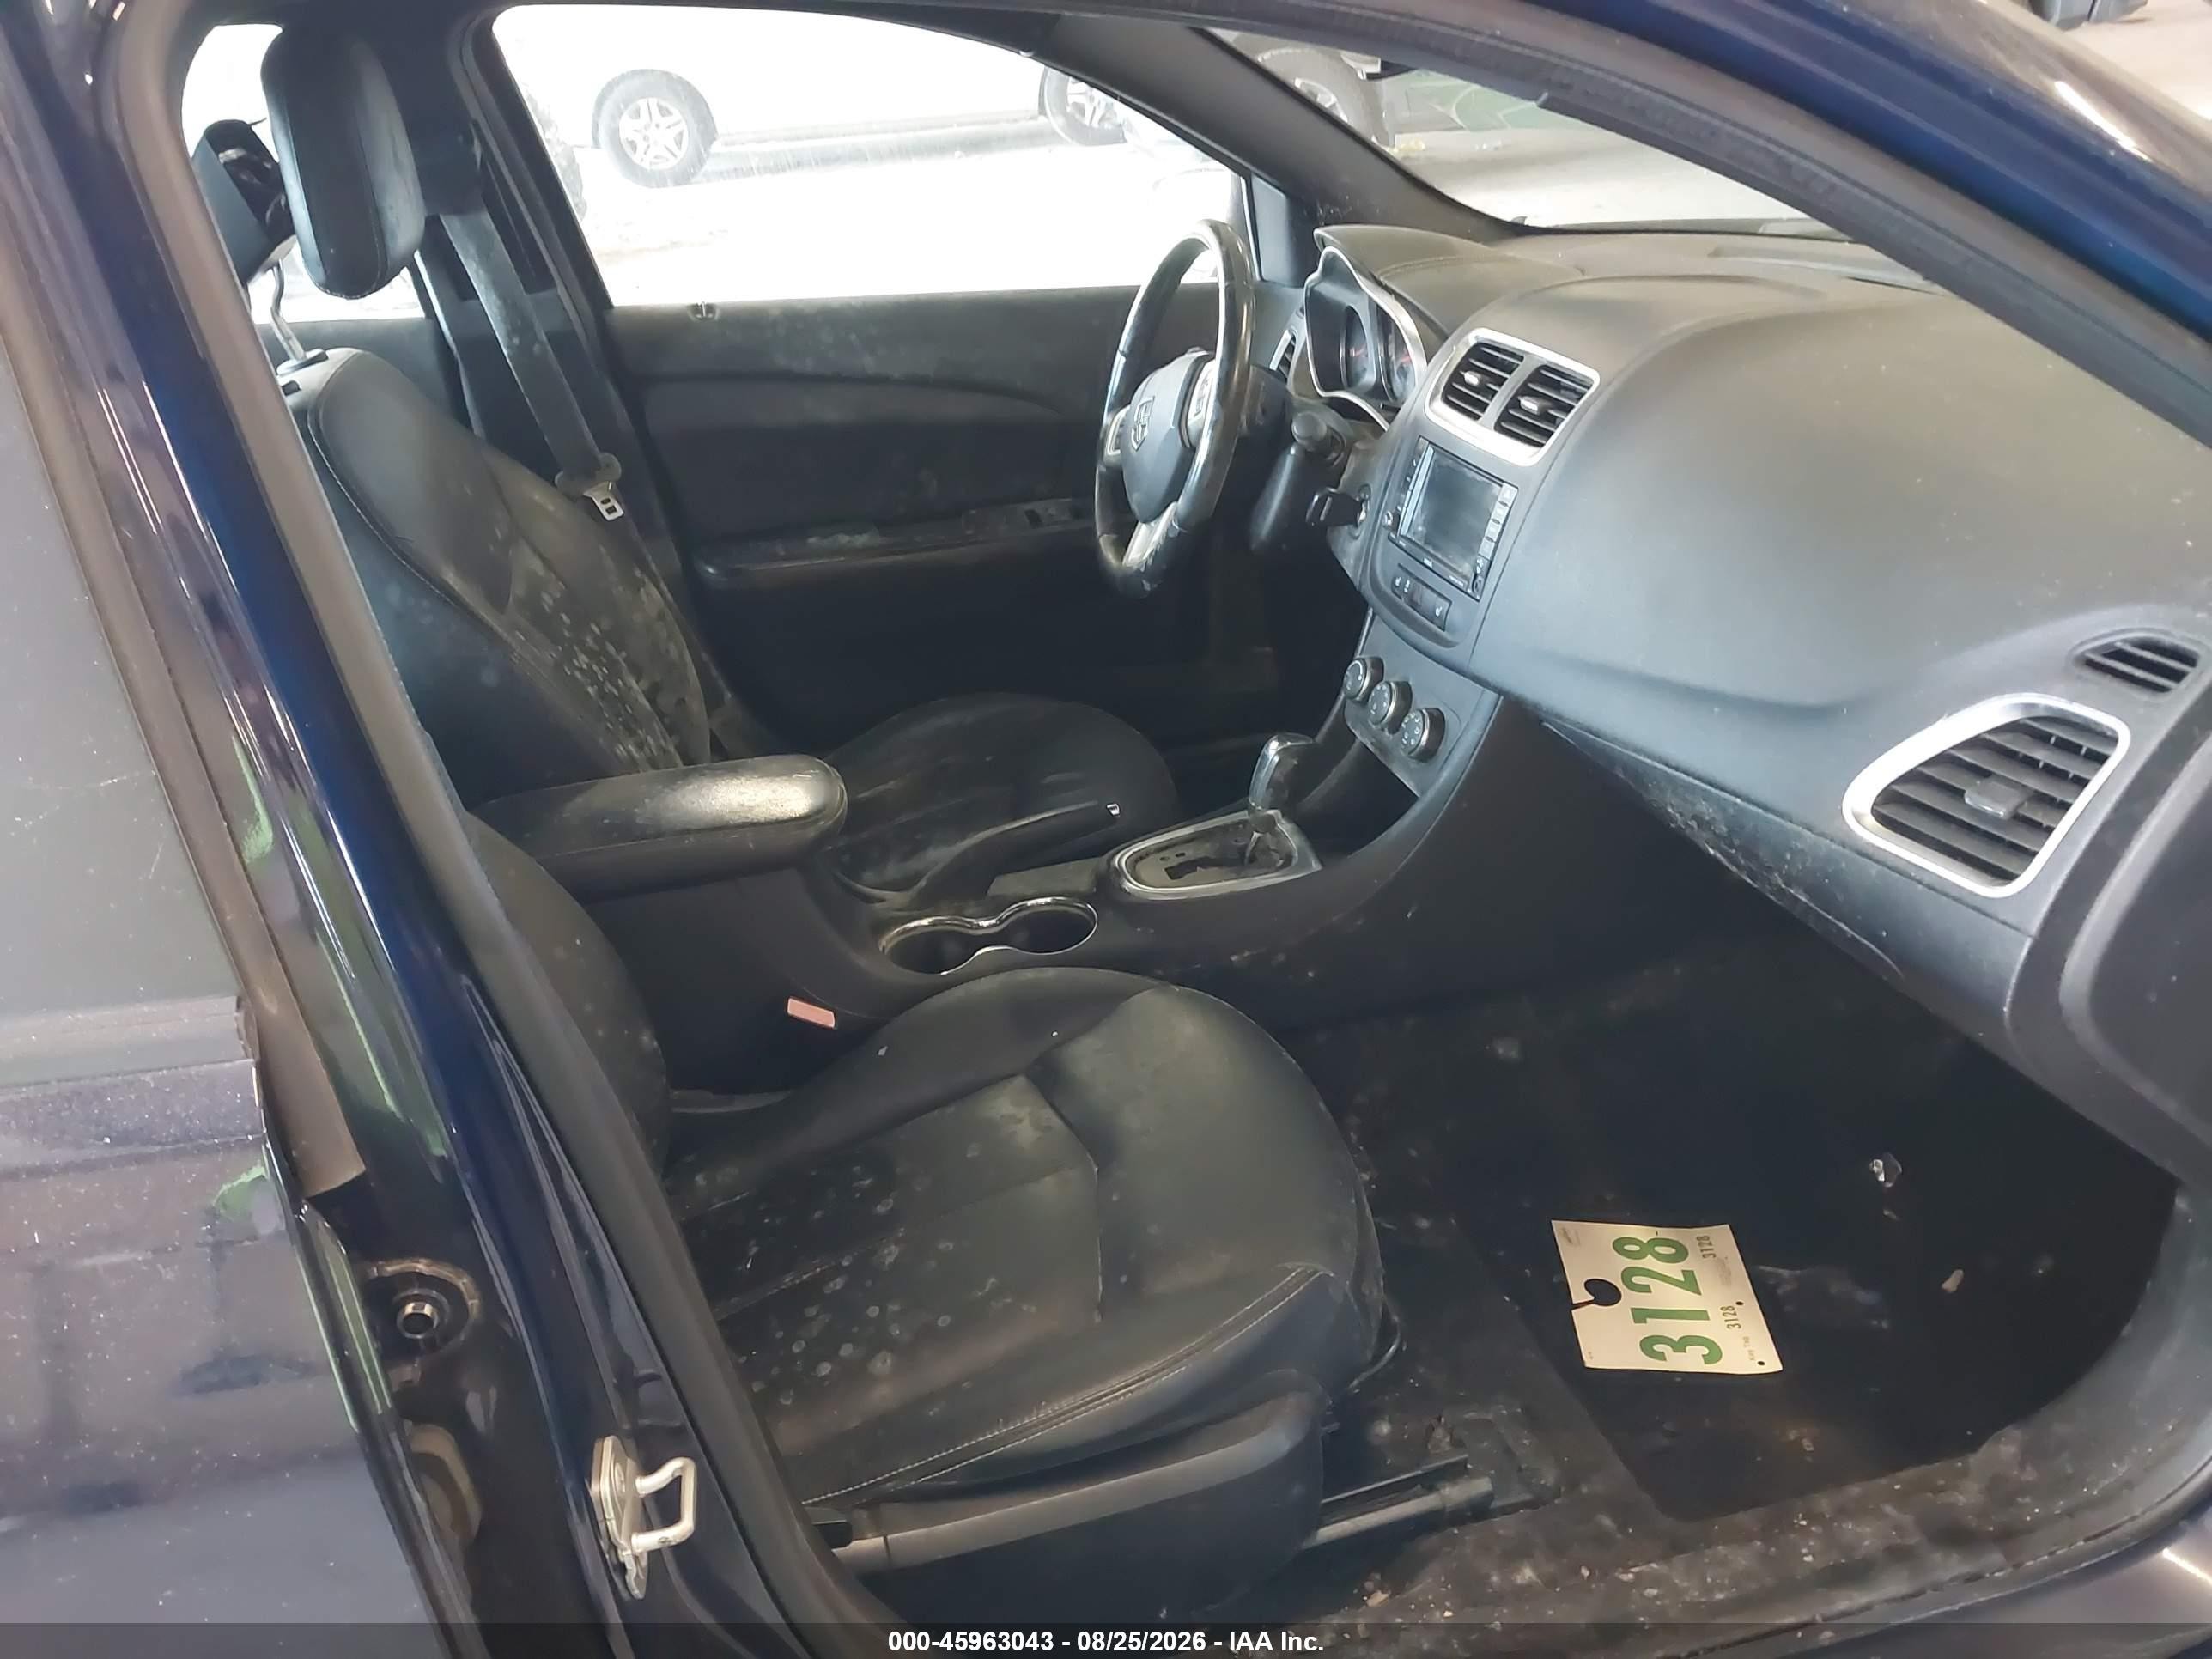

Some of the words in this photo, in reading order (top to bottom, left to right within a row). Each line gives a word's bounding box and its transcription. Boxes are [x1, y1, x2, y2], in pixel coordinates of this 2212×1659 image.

[1696, 1235, 1717, 1259] 3128
[1612, 1237, 1723, 1365] 3128
[1720, 1305, 1741, 1329] 3128
